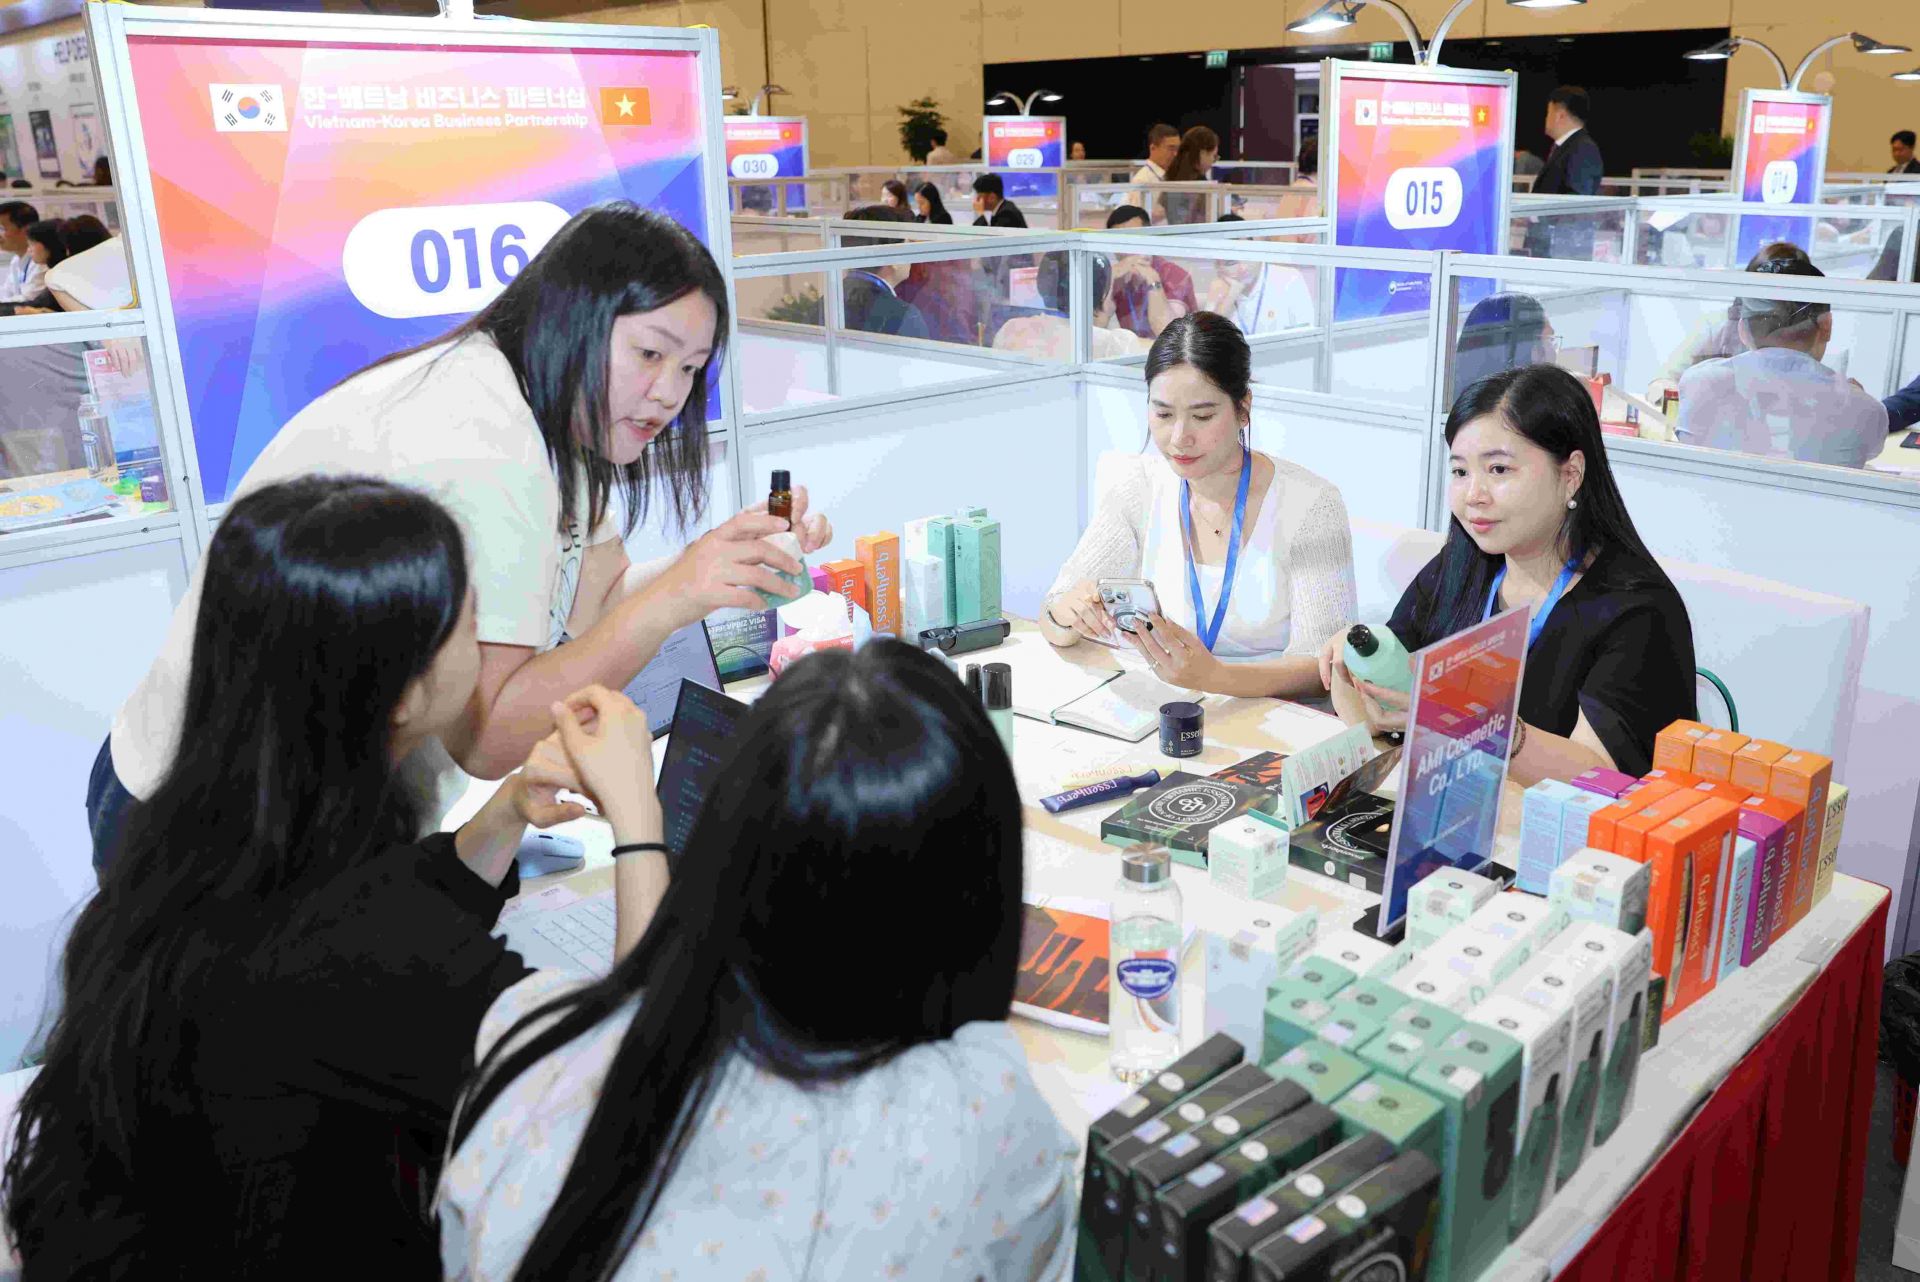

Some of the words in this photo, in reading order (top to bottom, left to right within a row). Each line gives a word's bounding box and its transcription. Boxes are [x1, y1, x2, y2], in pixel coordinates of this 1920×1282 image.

[303, 114, 430, 129] Vietnam-Korea
[434, 112, 501, 128] Business
[505, 111, 588, 128] Partnership
[414, 86, 500, 110] 비즈니스
[505, 86, 587, 110] 파트너십
[743, 159, 768, 174] 030
[1406, 180, 1443, 216] 015
[411, 223, 529, 294] 016
[1416, 748, 1444, 781] AMI
[1446, 714, 1506, 760] Cosmetic
[1056, 779, 1118, 804] Essenherb
[1752, 847, 1776, 951] Essenherb
[1771, 831, 1795, 931] Essenherb
[1689, 873, 1711, 962] Essenherb
